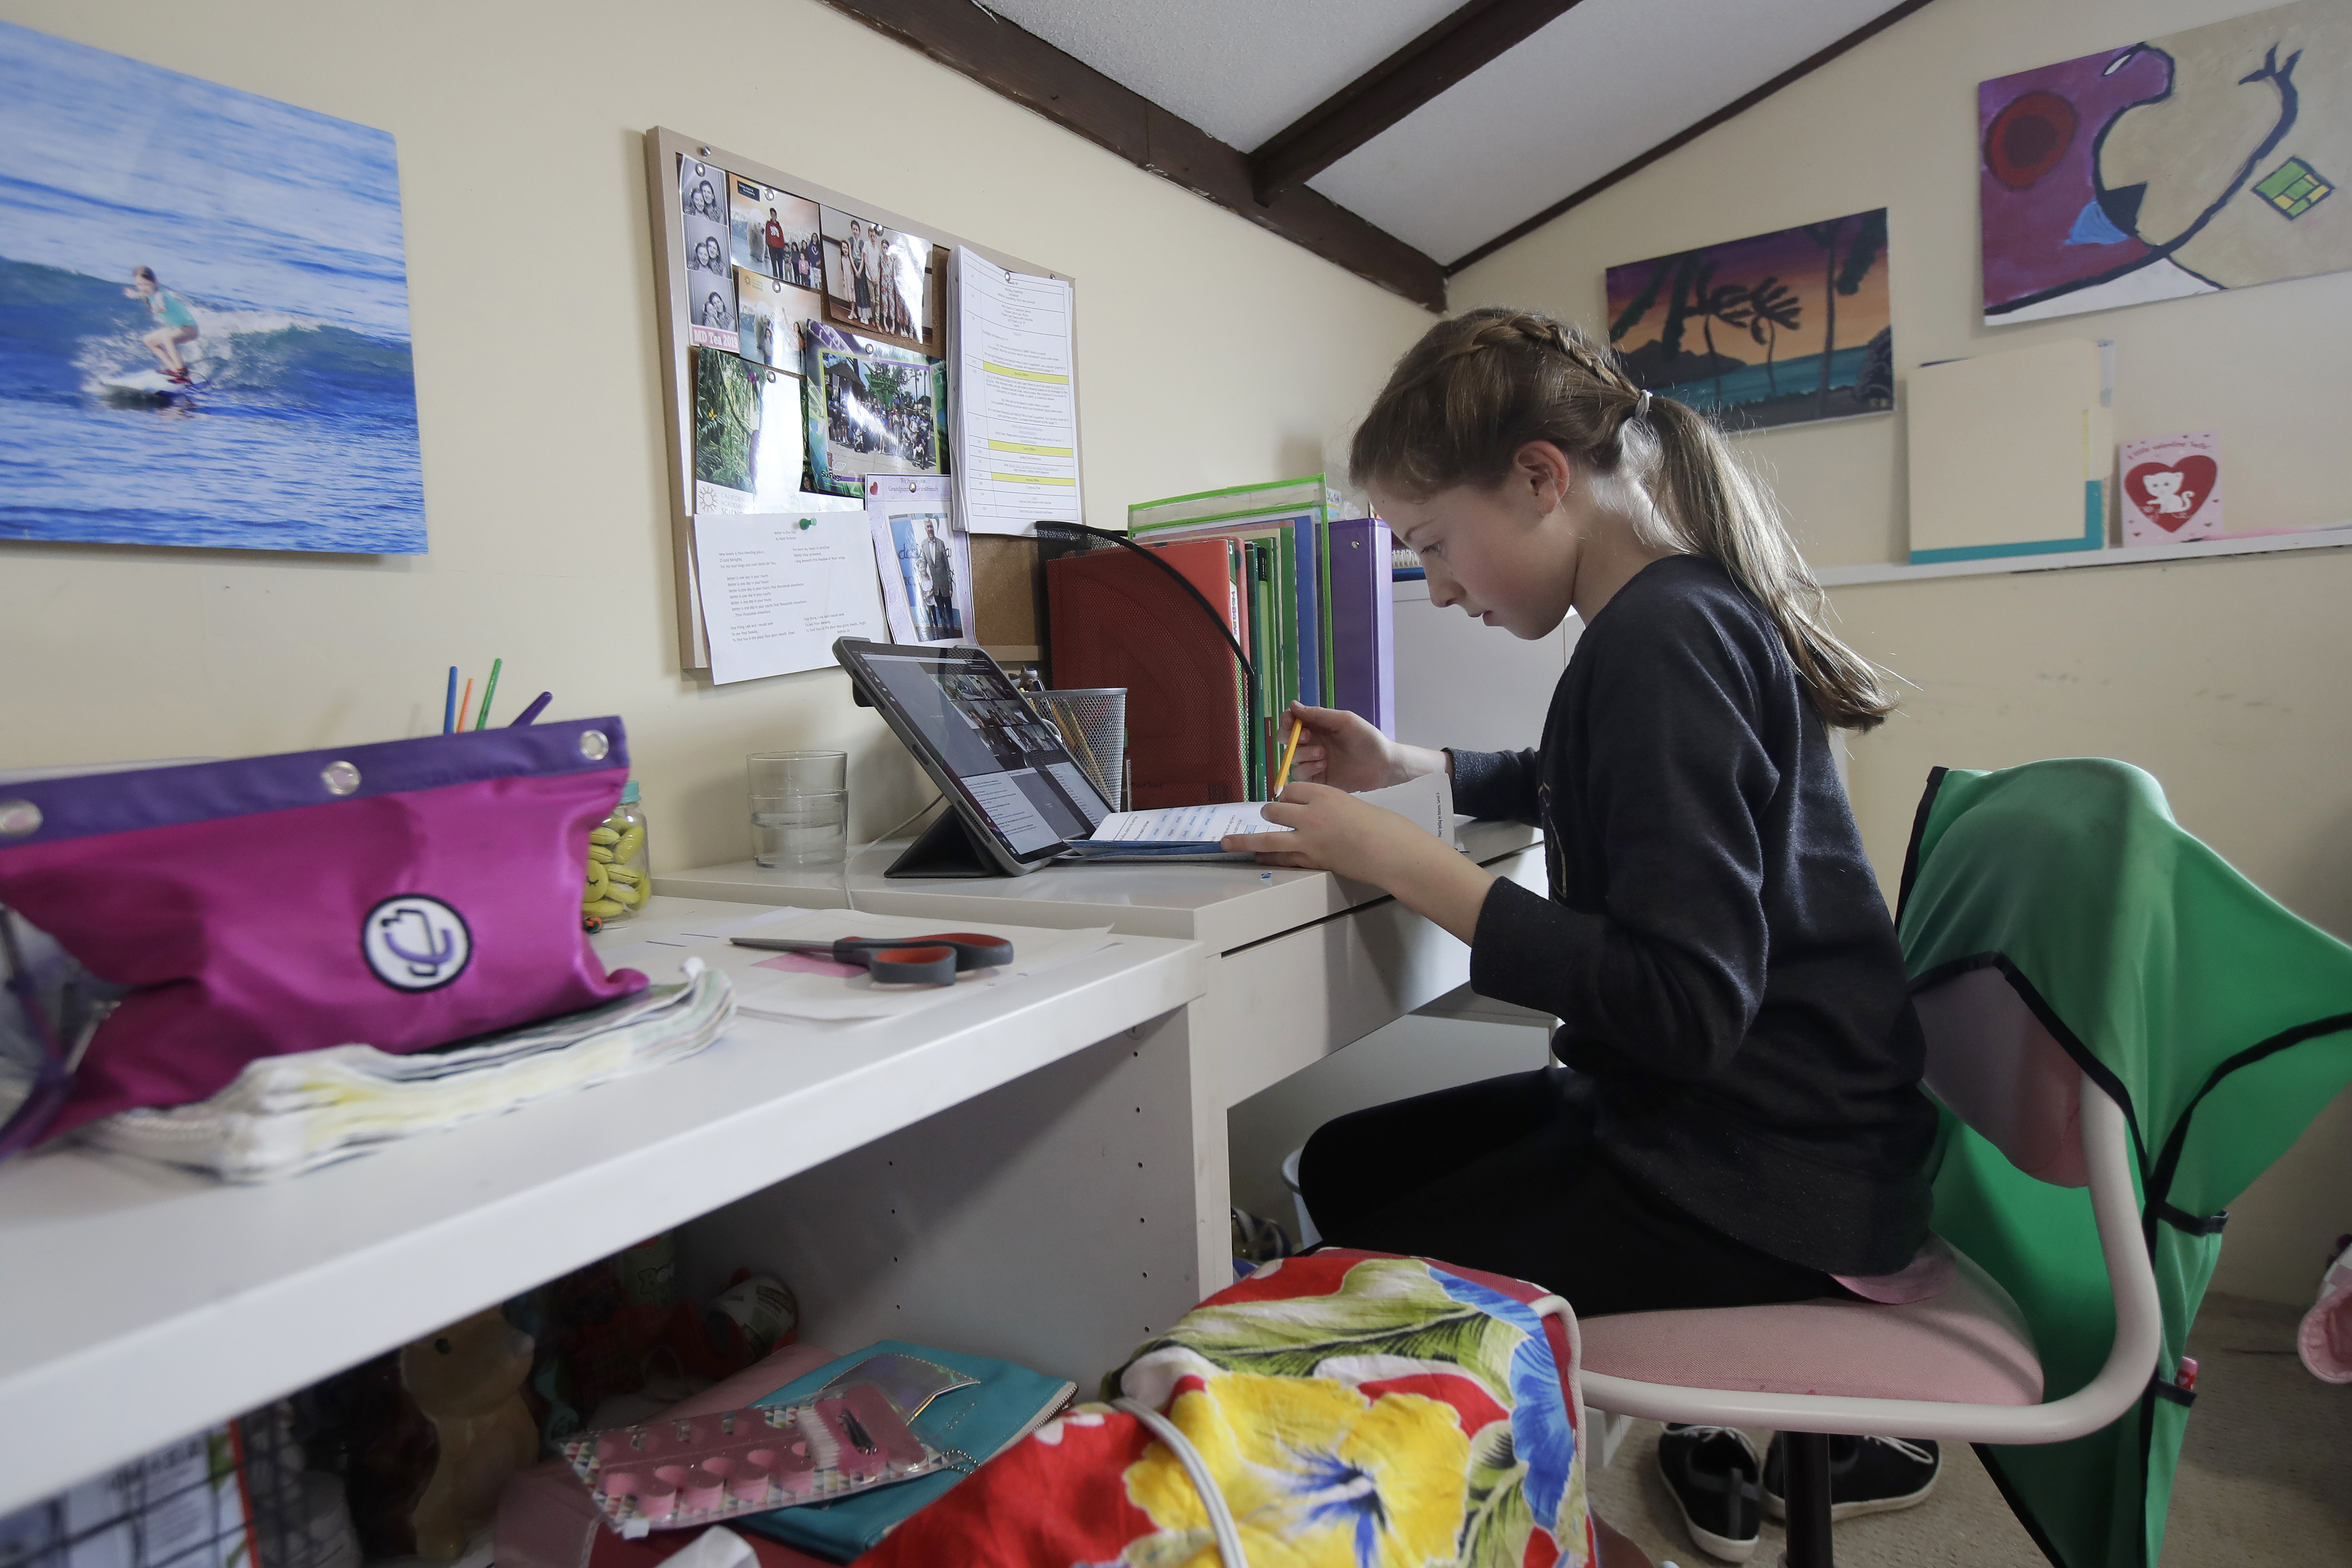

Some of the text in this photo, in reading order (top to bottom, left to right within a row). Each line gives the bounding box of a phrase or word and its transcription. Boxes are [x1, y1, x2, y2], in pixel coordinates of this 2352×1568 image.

[694, 329, 739, 349] MD Tea 2019
[821, 470, 842, 482] SixFlags
[1229, 544, 1234, 555] 3
